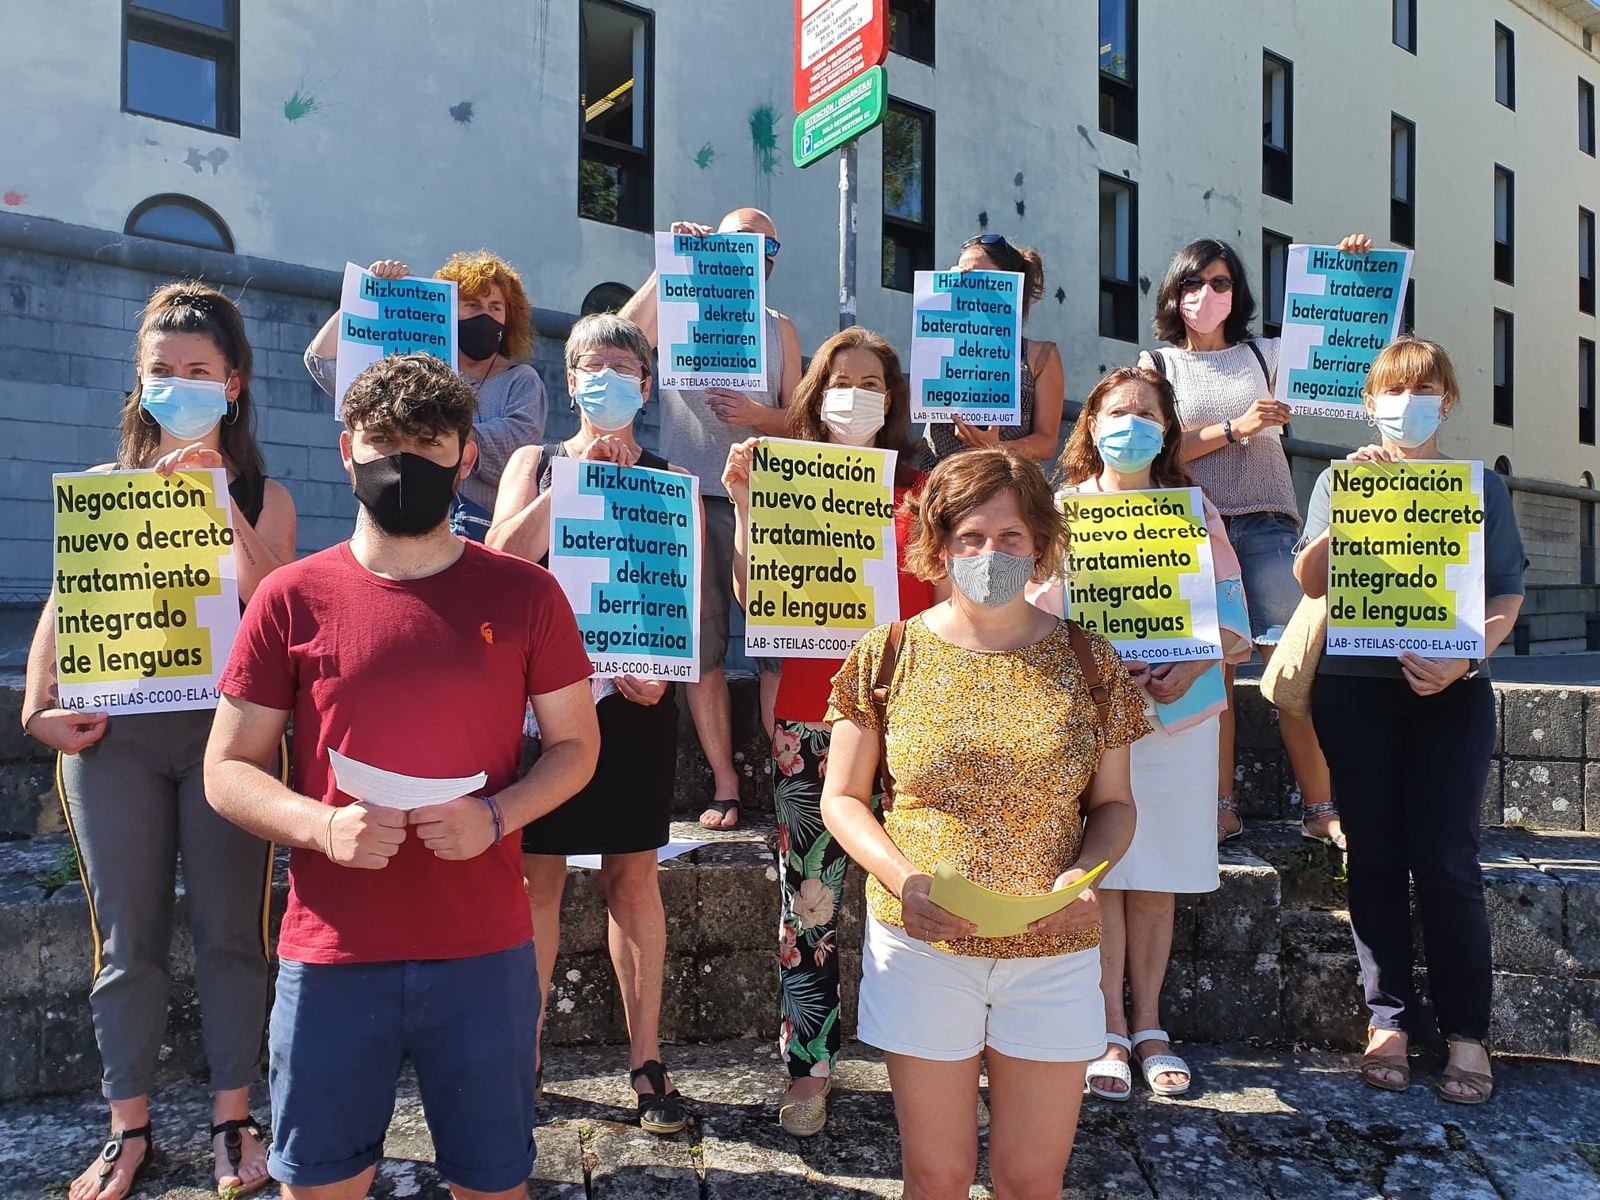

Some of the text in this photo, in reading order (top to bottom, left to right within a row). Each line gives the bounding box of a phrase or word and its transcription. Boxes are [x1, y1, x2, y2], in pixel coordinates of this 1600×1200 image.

[827, 35, 861, 63] OBLIGATORIO
[810, 42, 863, 84] INCLUSO RESIDENTES
[834, 107, 861, 128] RESIDENTES
[804, 136, 810, 154] P
[680, 235, 754, 254] Hizkuntzen
[698, 260, 754, 277] trataera
[1313, 250, 1398, 274] Hizkuntzen
[365, 278, 446, 303] Hizkuntzen
[666, 280, 755, 300] bateratuaren
[939, 273, 1013, 292] Hizkuntzen
[1330, 280, 1393, 299] trataera
[384, 306, 446, 324] trataera
[704, 304, 755, 323] dekretu
[956, 297, 1012, 315] trataera
[1292, 299, 1389, 324] bateratuaren
[348, 319, 446, 346] bateratuaren
[693, 326, 756, 346] berriaren
[922, 316, 1011, 337] bateratuaren
[959, 340, 1010, 360] dekretu
[1328, 328, 1384, 350] dekretu
[676, 352, 757, 371] negoziazioa
[946, 362, 1010, 382] berriaren
[1313, 352, 1371, 374] berriare
[662, 378, 761, 388] LAB- STEILAS-CCOO-ELA-UGT
[927, 387, 1010, 406] negoziazioa
[914, 412, 930, 420] LAB-
[752, 447, 875, 483] Negociación
[586, 465, 686, 499] Hizkuntzen
[1333, 469, 1463, 499] Negociación
[56, 480, 206, 520] Negociación
[752, 488, 894, 519] nuevo decreto
[1064, 498, 1185, 524] Negociación
[1333, 500, 1485, 524] nuevo decreto
[612, 501, 687, 528] trataera
[57, 531, 129, 553] nuevo
[136, 520, 234, 550] decreto
[563, 525, 687, 558] bateratuaren
[751, 522, 875, 551] tratamiento
[1133, 523, 1209, 540] decreto
[1331, 533, 1461, 557] tratamiento
[1068, 548, 1191, 572] tratamiento
[56, 562, 210, 594] tratamiento
[617, 560, 687, 588] dekretu
[750, 556, 857, 590] integrado
[1331, 564, 1438, 595] integrado
[1071, 576, 1172, 608] integrado
[598, 590, 687, 619] berriaren
[749, 591, 867, 626] de lenguas
[1330, 596, 1448, 627] de lenguas
[58, 600, 187, 640] integrado
[1103, 611, 1185, 639] lenguas
[747, 637, 770, 649] LAB-
[1328, 638, 1478, 651] LAB- STEILAS-CCOO-ELA-UGT
[60, 644, 202, 677] de lenguas
[62, 696, 90, 710] LAB-
